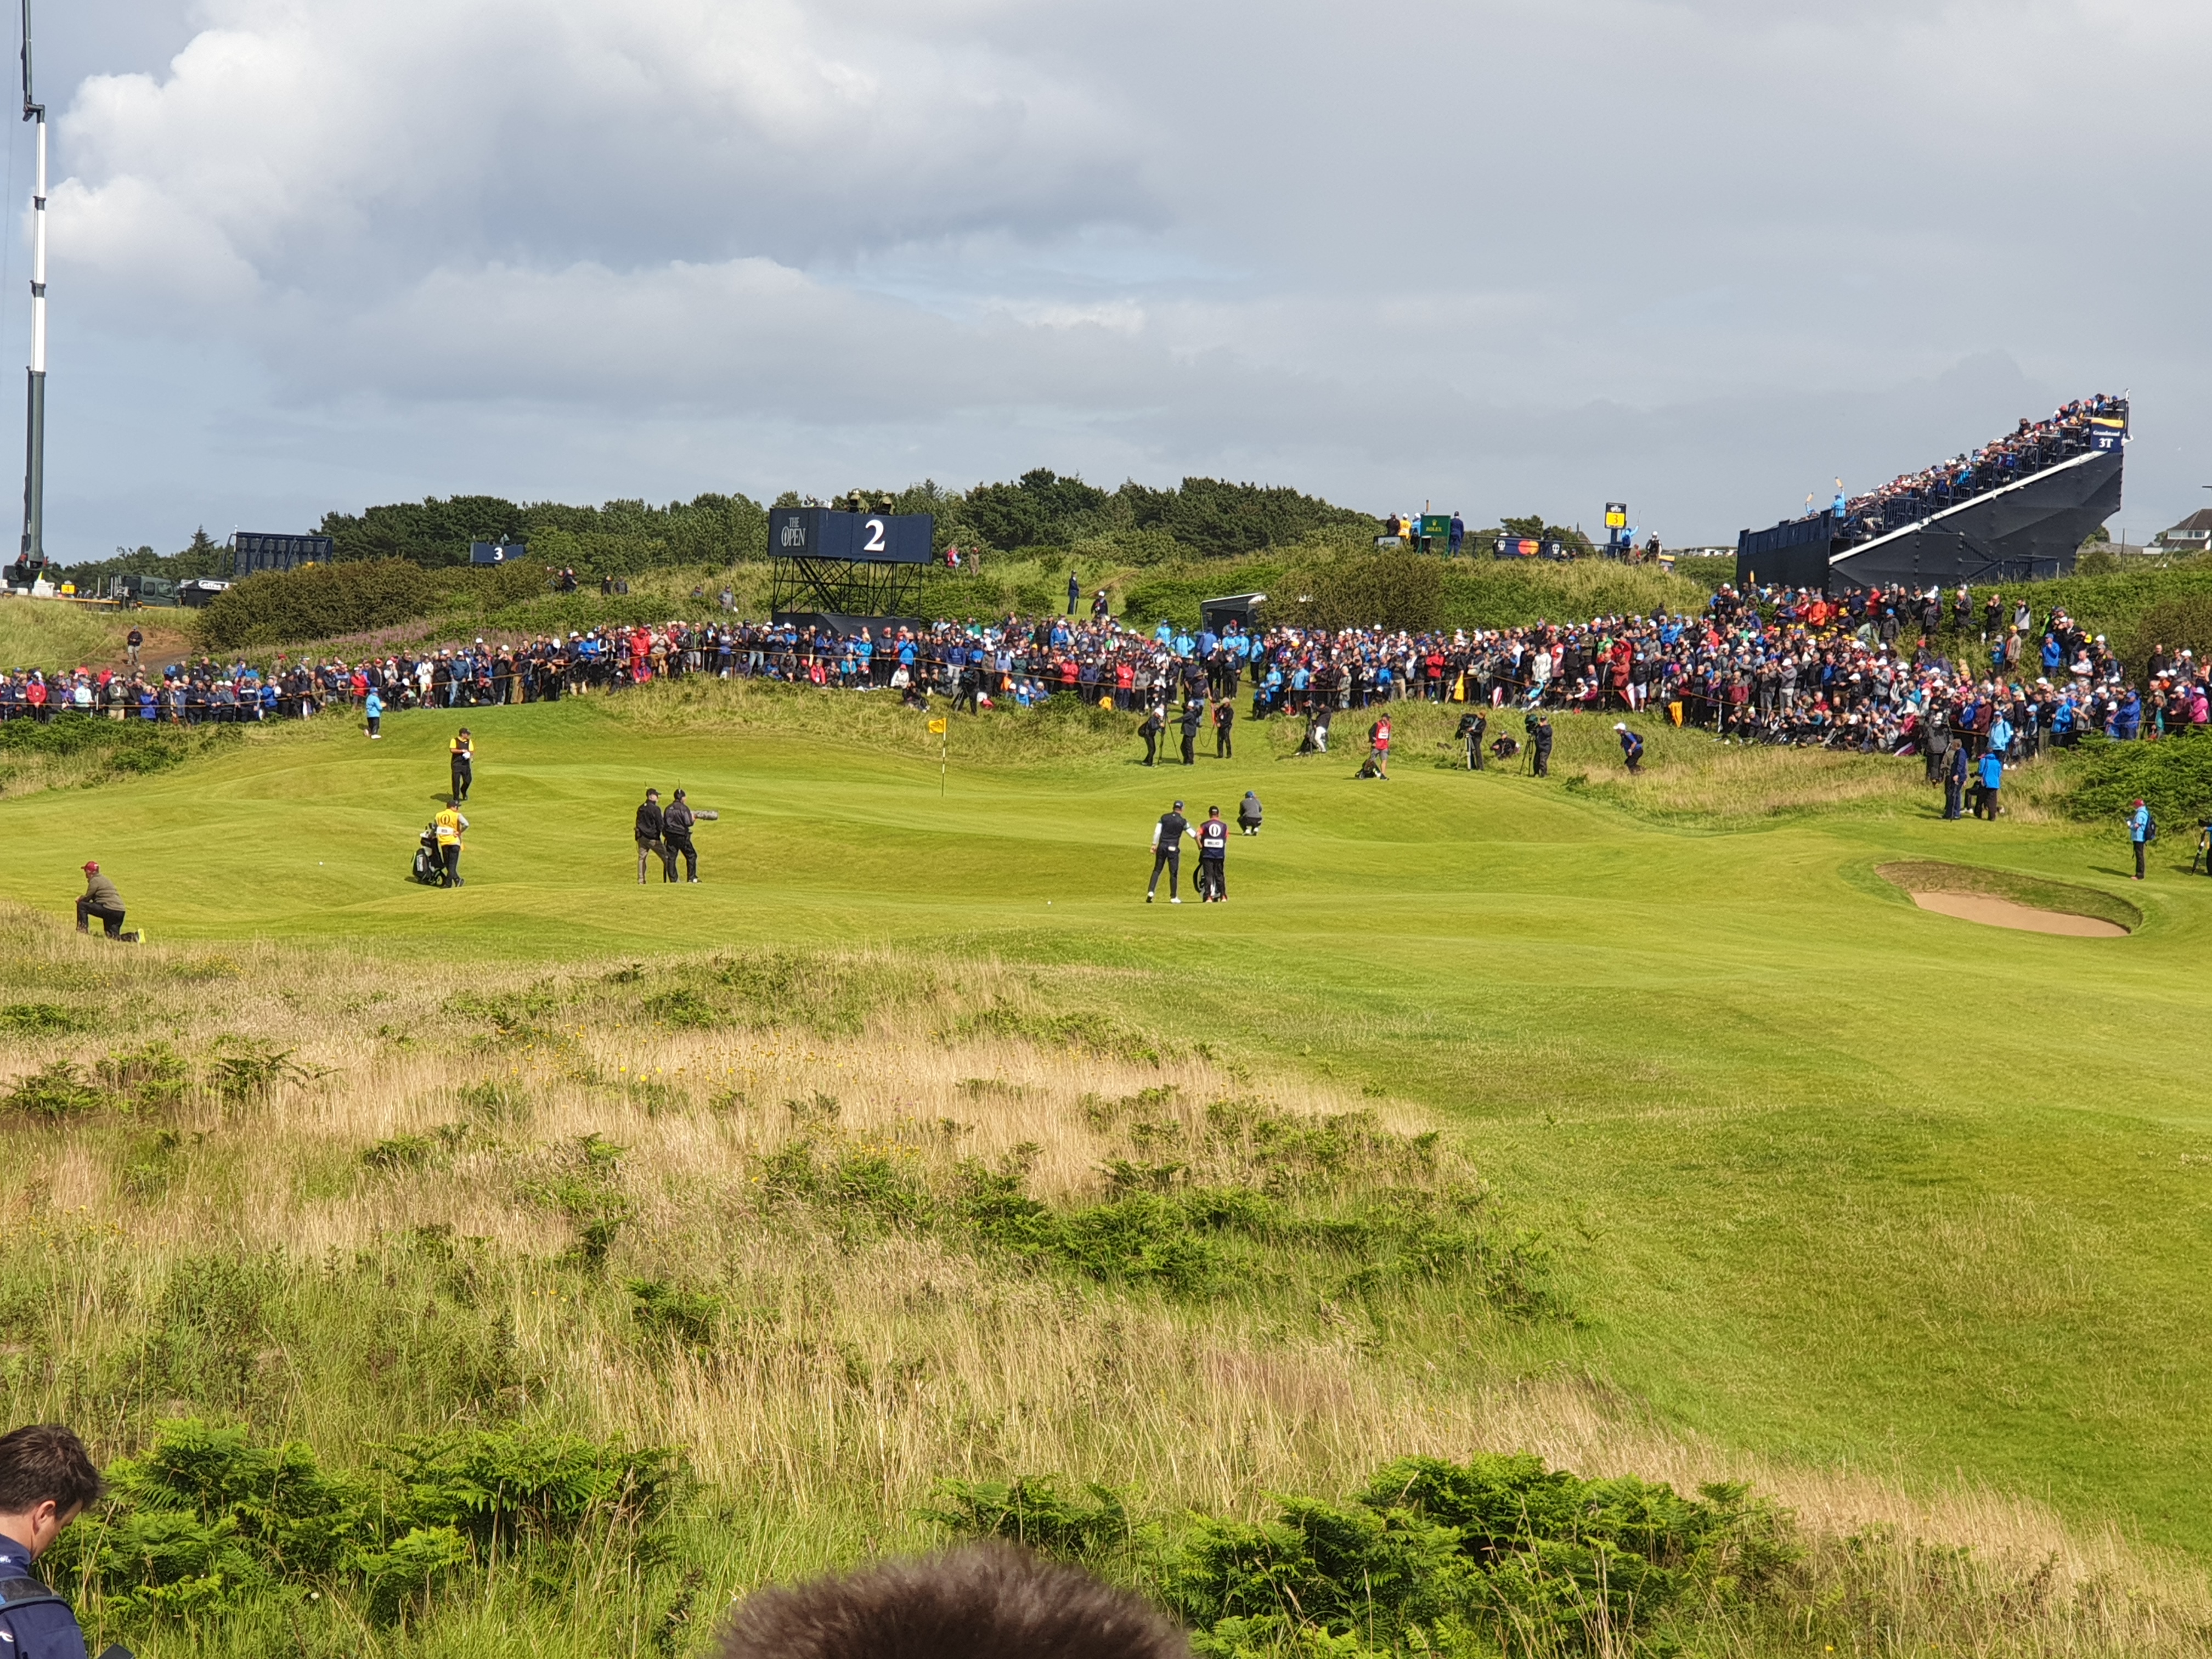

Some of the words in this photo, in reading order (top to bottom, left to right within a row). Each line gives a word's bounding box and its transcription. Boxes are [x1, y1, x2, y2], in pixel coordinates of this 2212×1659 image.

[2098, 438, 2113, 448] 3T
[788, 517, 800, 527] THE
[1612, 514, 1618, 524] 3
[781, 526, 806, 547] OPEN
[864, 520, 885, 551] 2
[494, 547, 503, 561] 3
